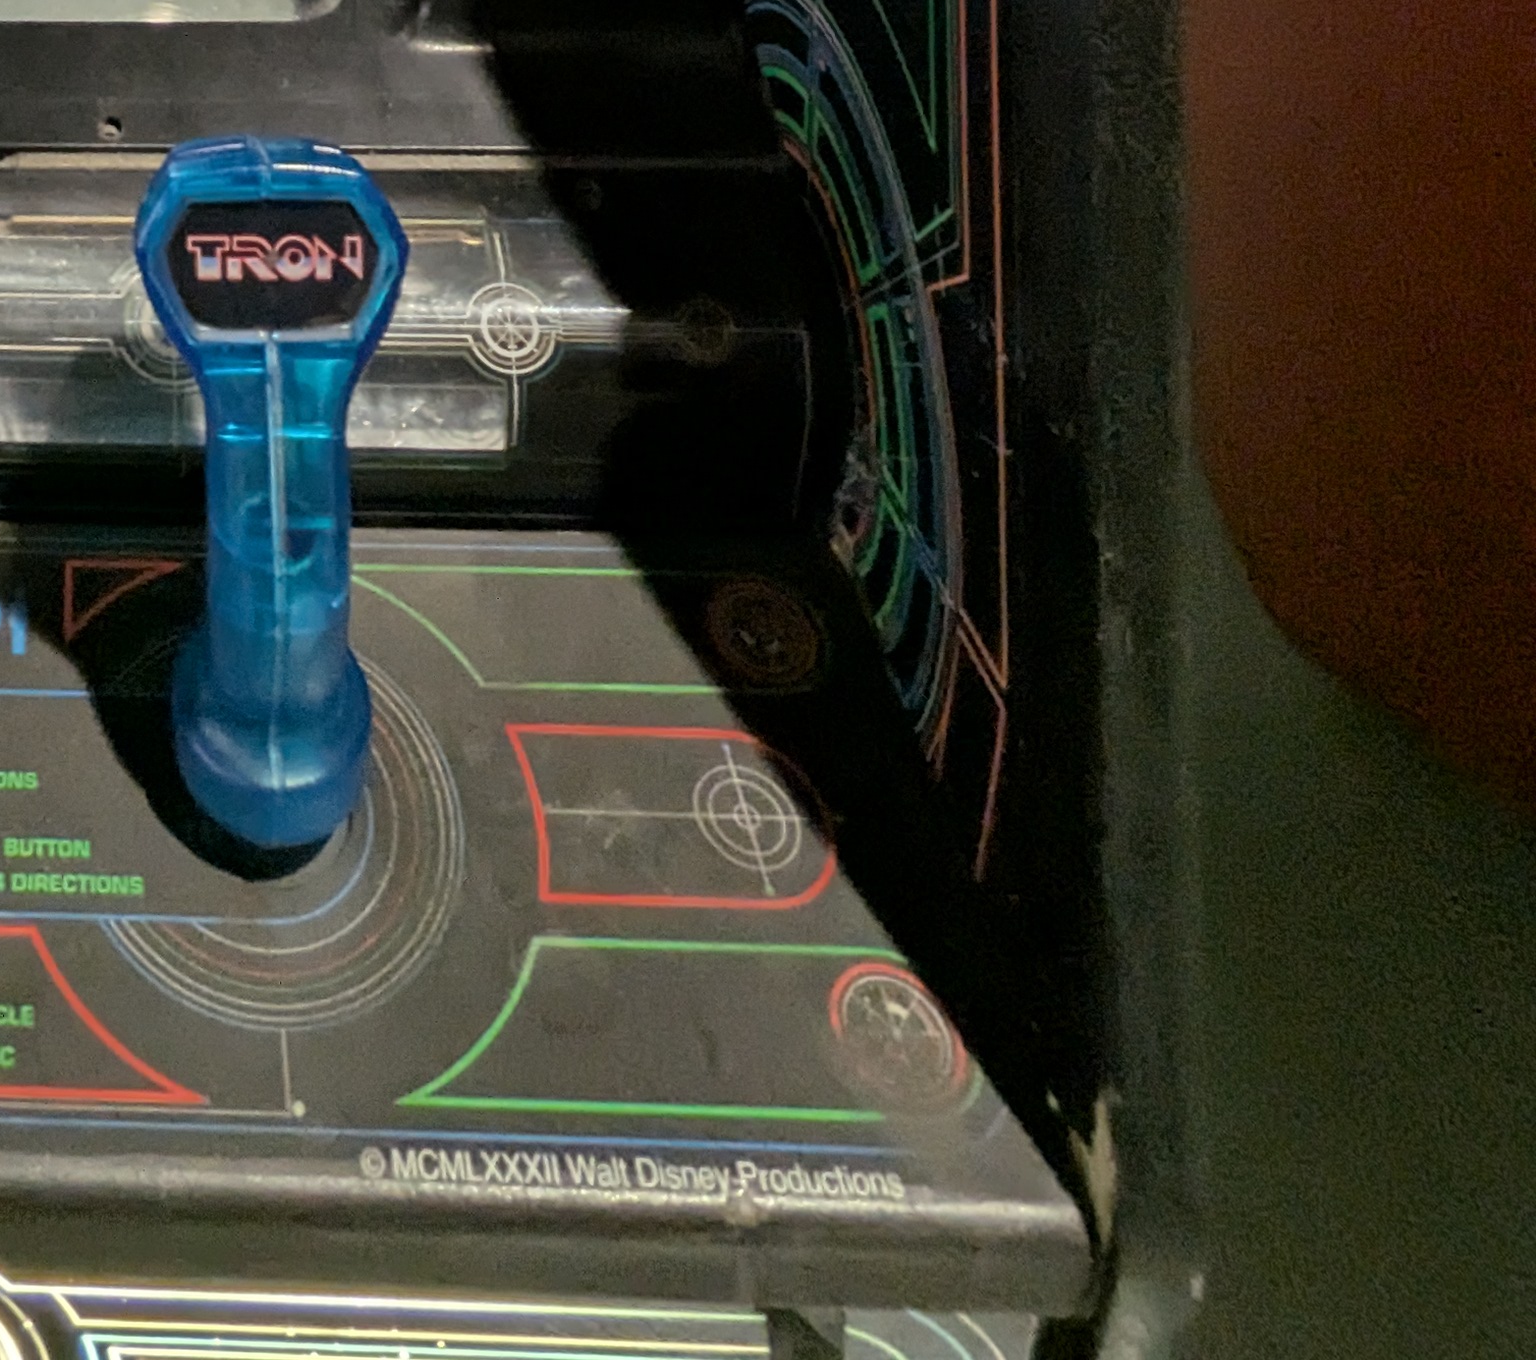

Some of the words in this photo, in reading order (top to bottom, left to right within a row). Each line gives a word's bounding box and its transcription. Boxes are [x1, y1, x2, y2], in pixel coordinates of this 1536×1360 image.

[186, 233, 364, 281] TRON
[3, 837, 91, 858] BUTTON
[10, 873, 144, 895] DIRECTIONS
[390, 1147, 561, 1185] MCMLXXXII
[565, 1153, 631, 1189] Walt
[635, 1156, 730, 1198] Disney
[734, 1159, 905, 1198] Productions
